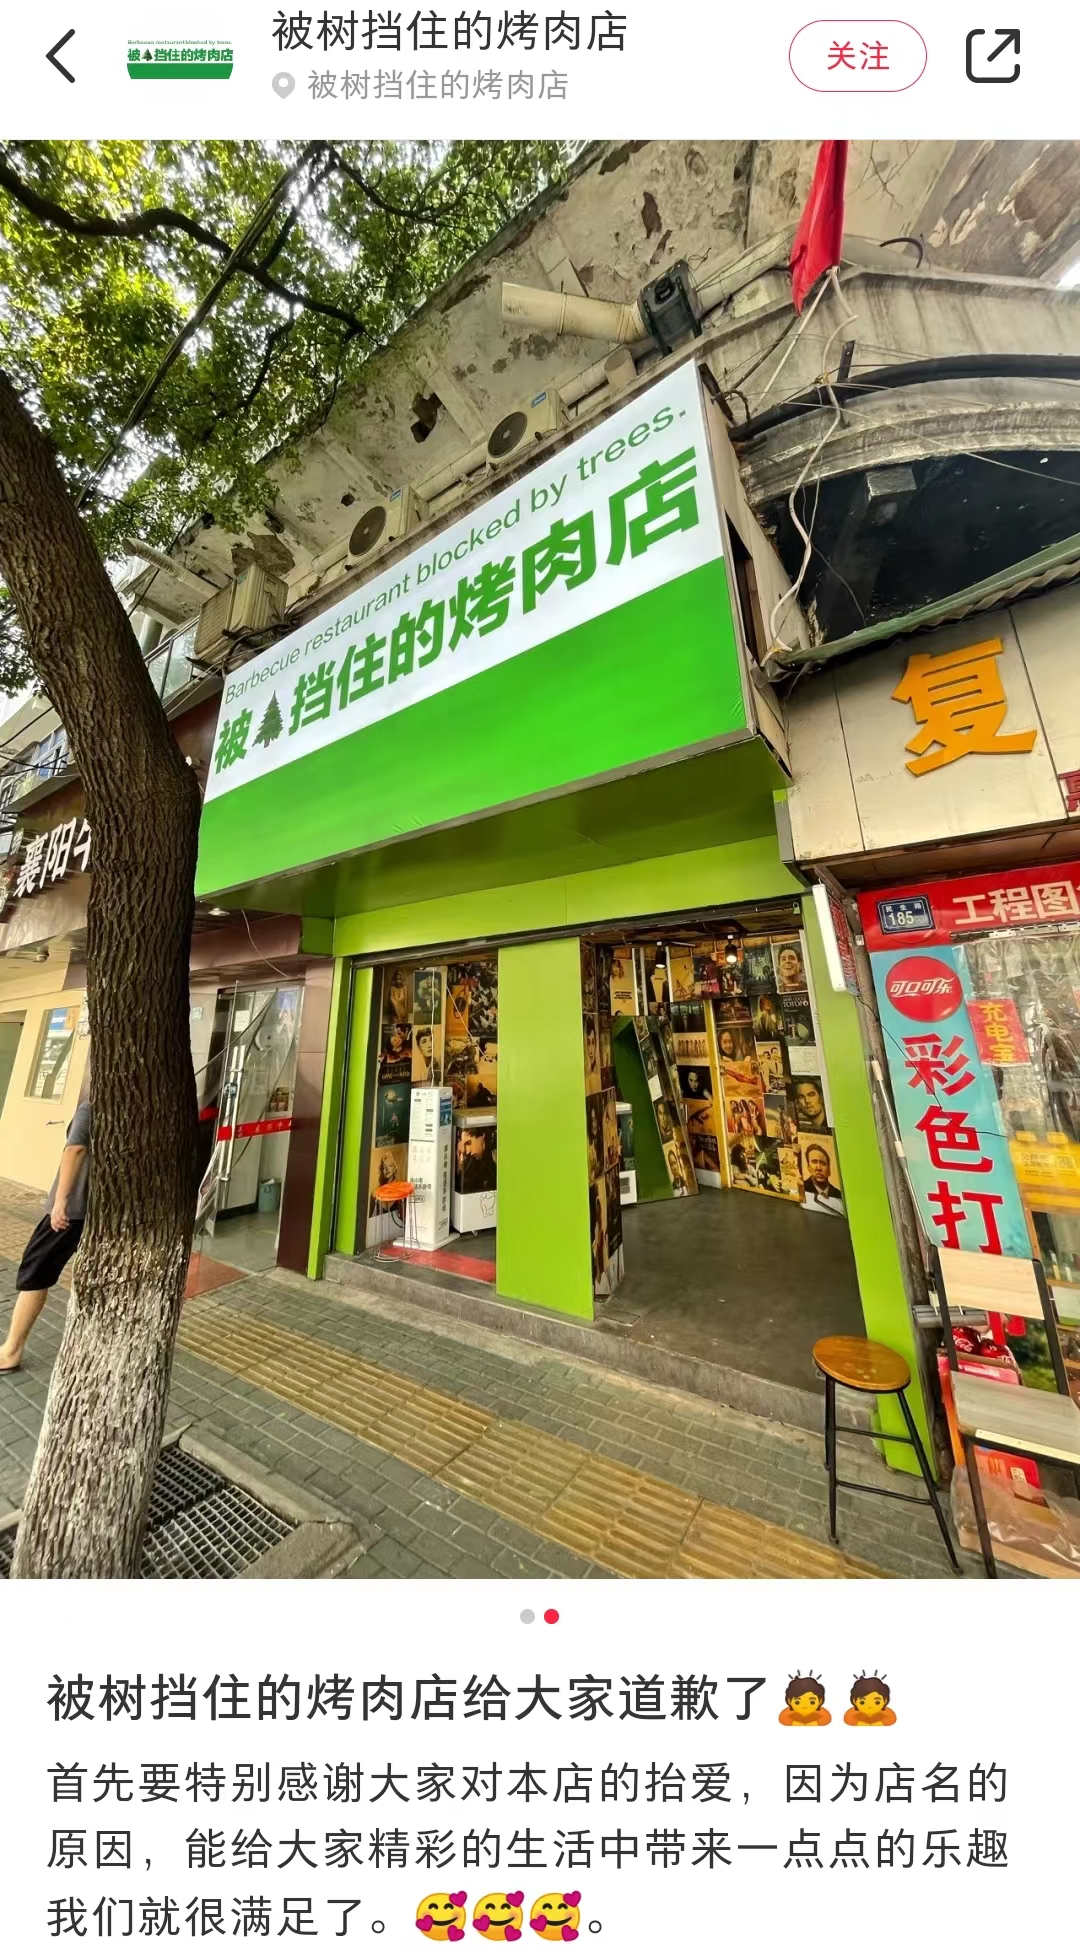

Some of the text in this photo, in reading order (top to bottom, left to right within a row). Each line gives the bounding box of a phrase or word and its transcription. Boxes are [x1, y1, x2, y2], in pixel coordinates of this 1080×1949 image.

[224, 406, 687, 705] Barbecue restaurant blocked by trees.
[891, 637, 1038, 777] 复
[214, 708, 253, 775] 被
[888, 910, 915, 926] 185
[952, 879, 1080, 925] 工程图
[889, 976, 955, 998] 可口可乐
[979, 1001, 1016, 1064] 充电宝
[901, 1032, 1004, 1256] 彩色打
